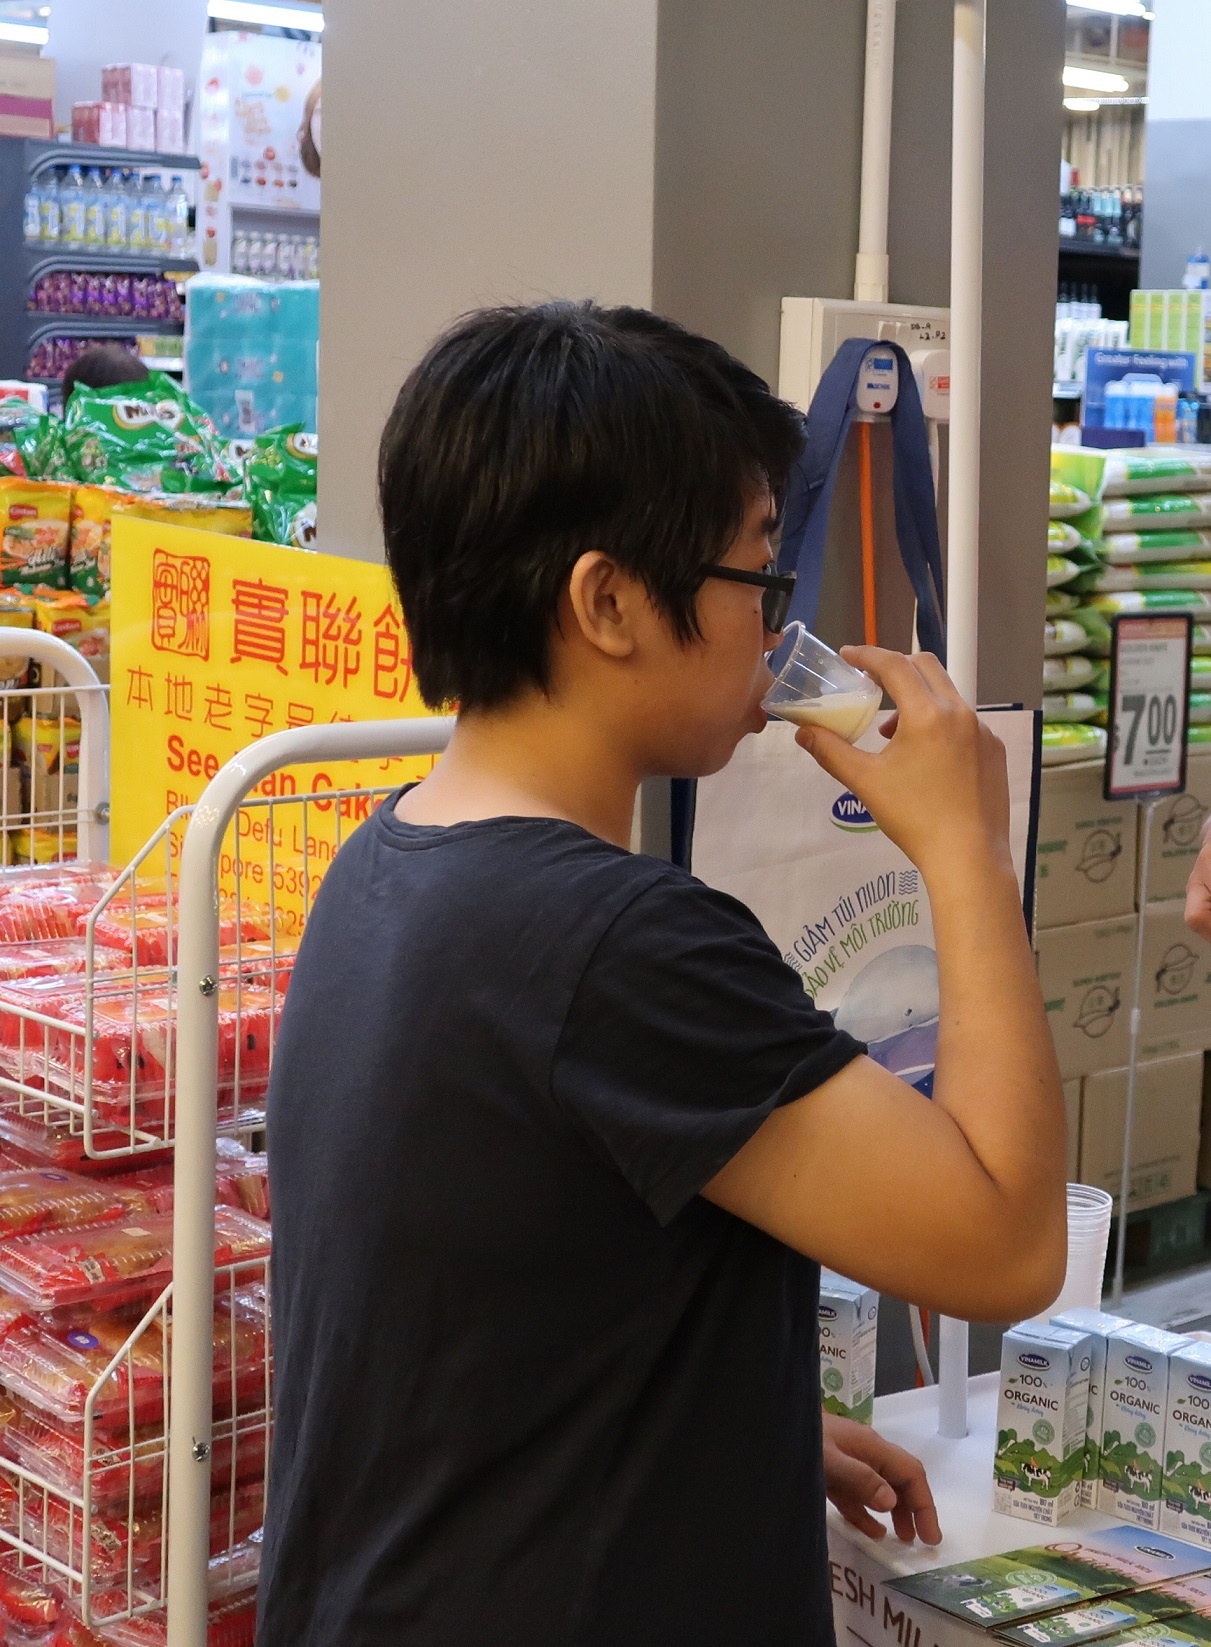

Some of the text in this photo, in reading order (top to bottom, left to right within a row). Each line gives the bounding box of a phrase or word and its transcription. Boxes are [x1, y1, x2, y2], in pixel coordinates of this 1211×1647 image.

[166, 734, 219, 780] See
[312, 772, 384, 820] Cak
[237, 808, 282, 848] Defu
[1020, 1356, 1050, 1368] VINAMILK
[1004, 1388, 1058, 1412] ORGANIC
[1110, 1390, 1160, 1414] ORGANIC
[883, 1596, 938, 1647] MIL
